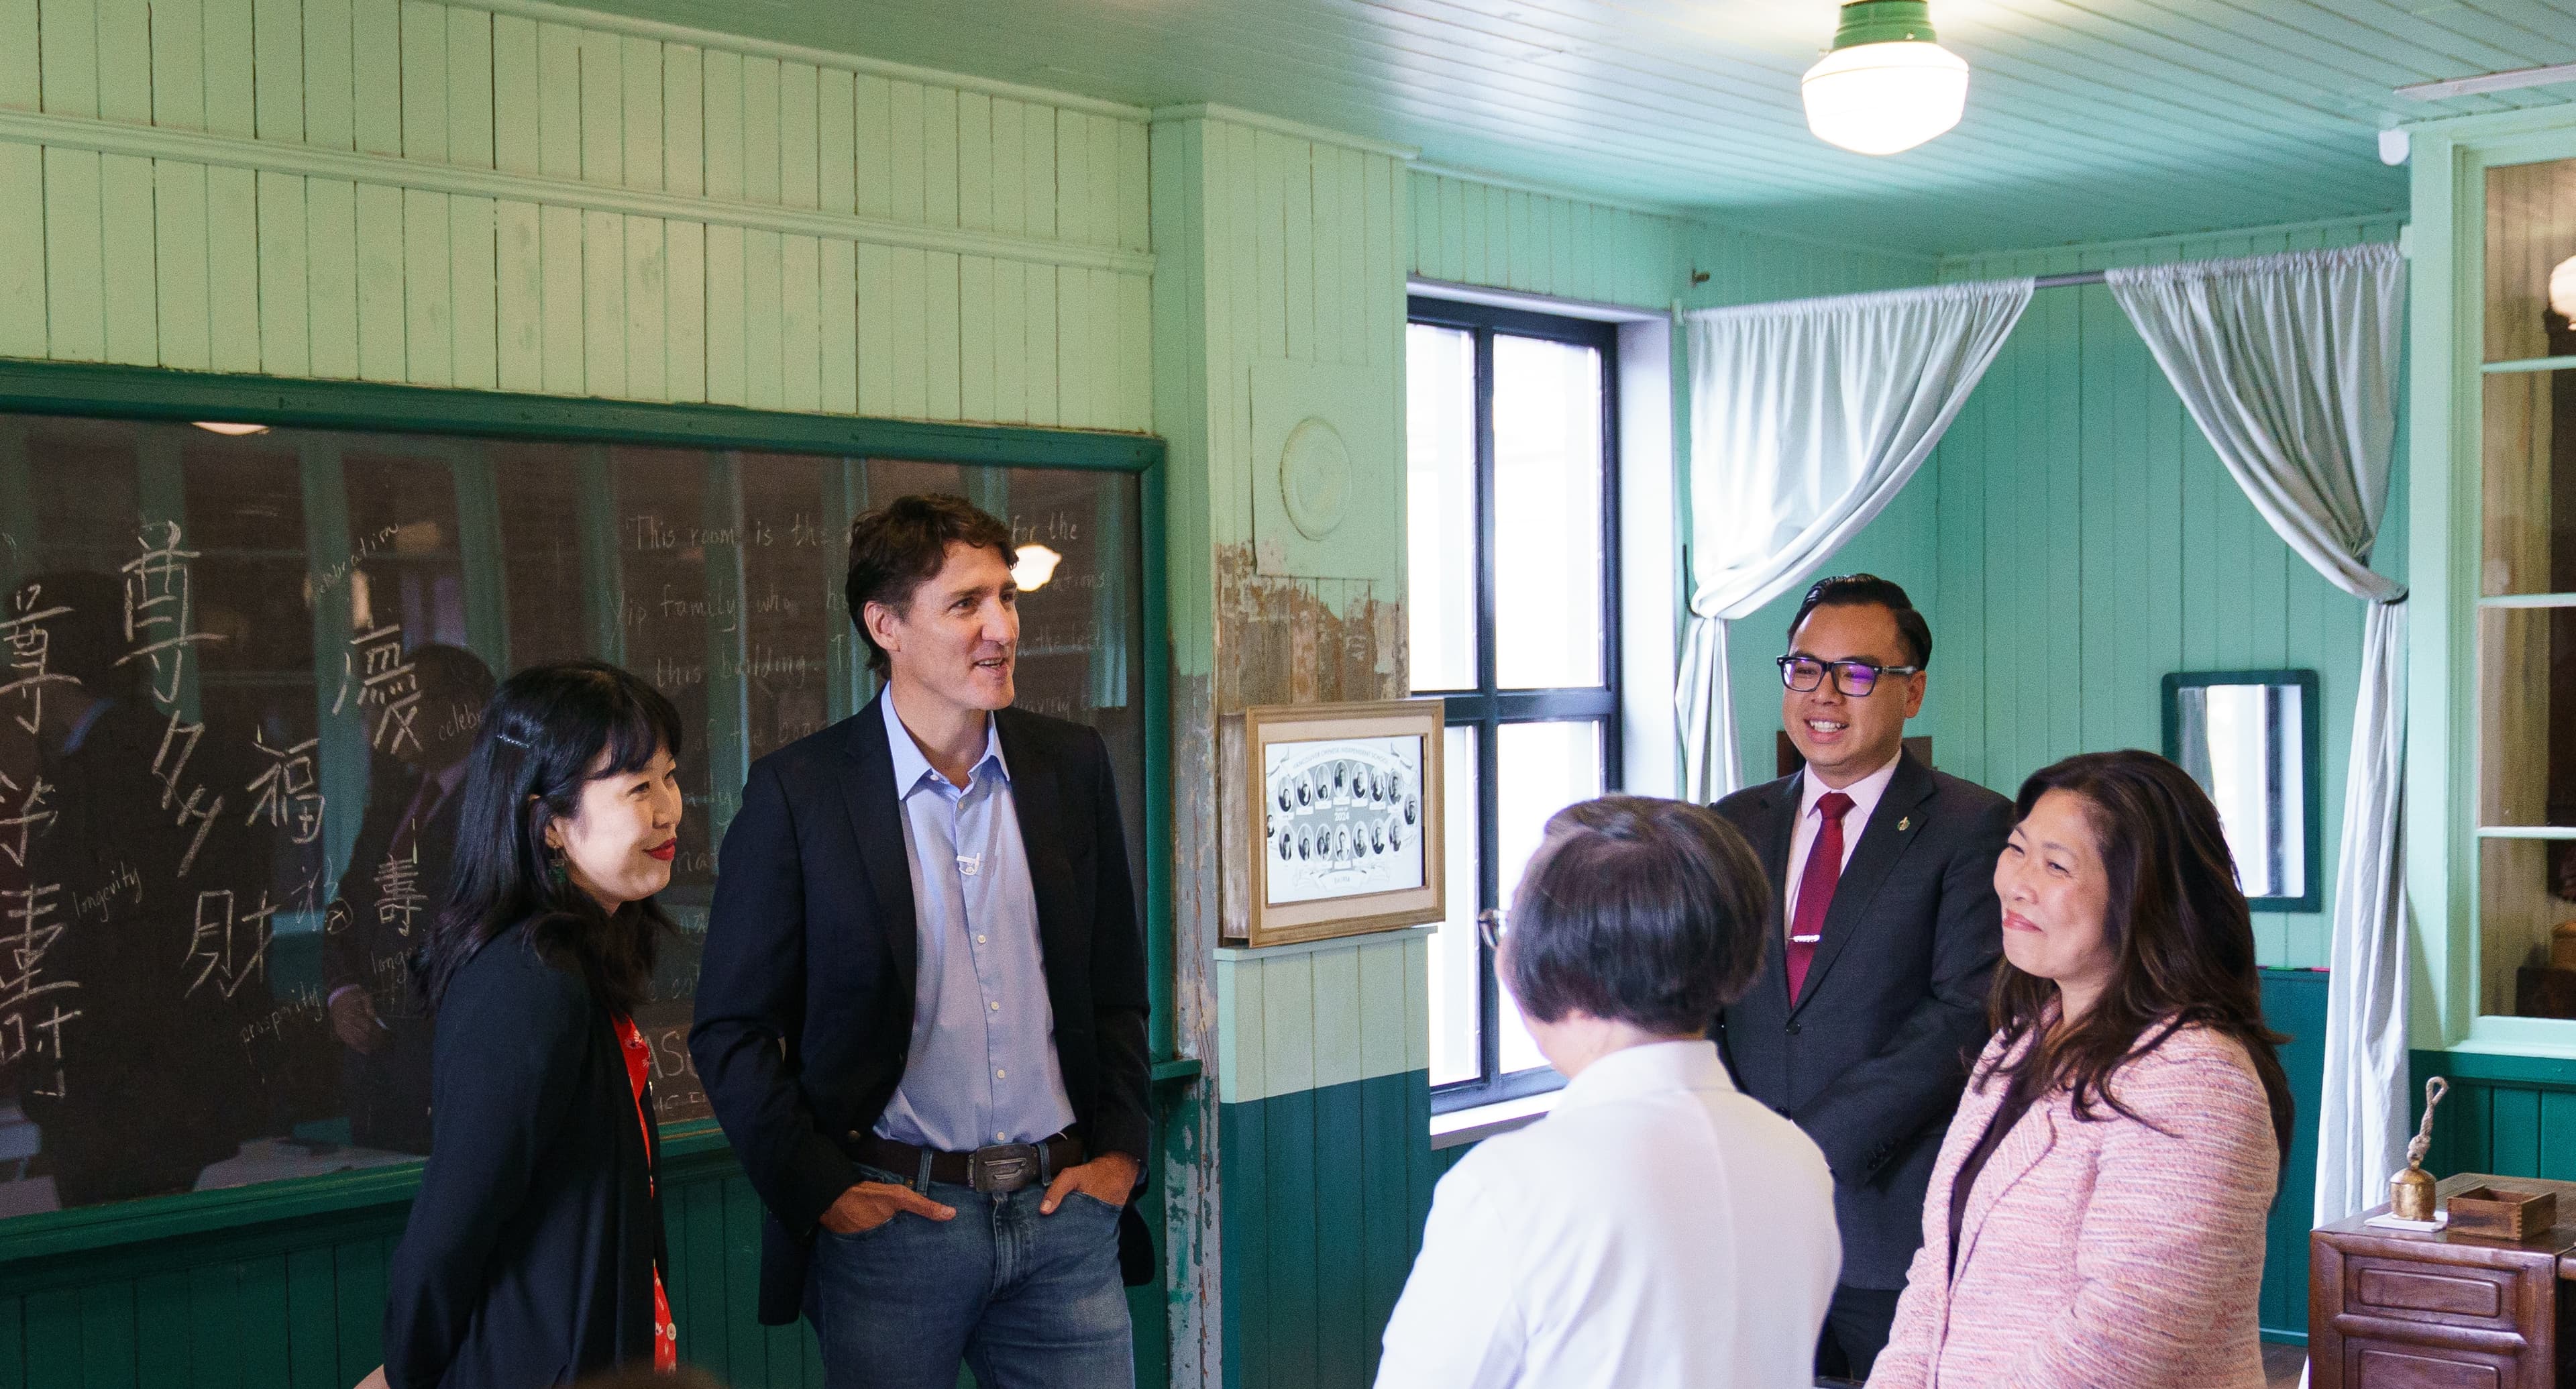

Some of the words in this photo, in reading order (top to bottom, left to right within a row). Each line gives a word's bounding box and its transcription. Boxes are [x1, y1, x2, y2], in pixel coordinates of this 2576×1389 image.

[626, 513, 676, 550] This
[690, 526, 735, 549] room
[756, 521, 773, 547] is
[1049, 511, 1077, 540] the
[659, 579, 737, 632] family
[755, 582, 790, 612] who
[656, 657, 701, 688] this
[245, 723, 325, 844] 福
